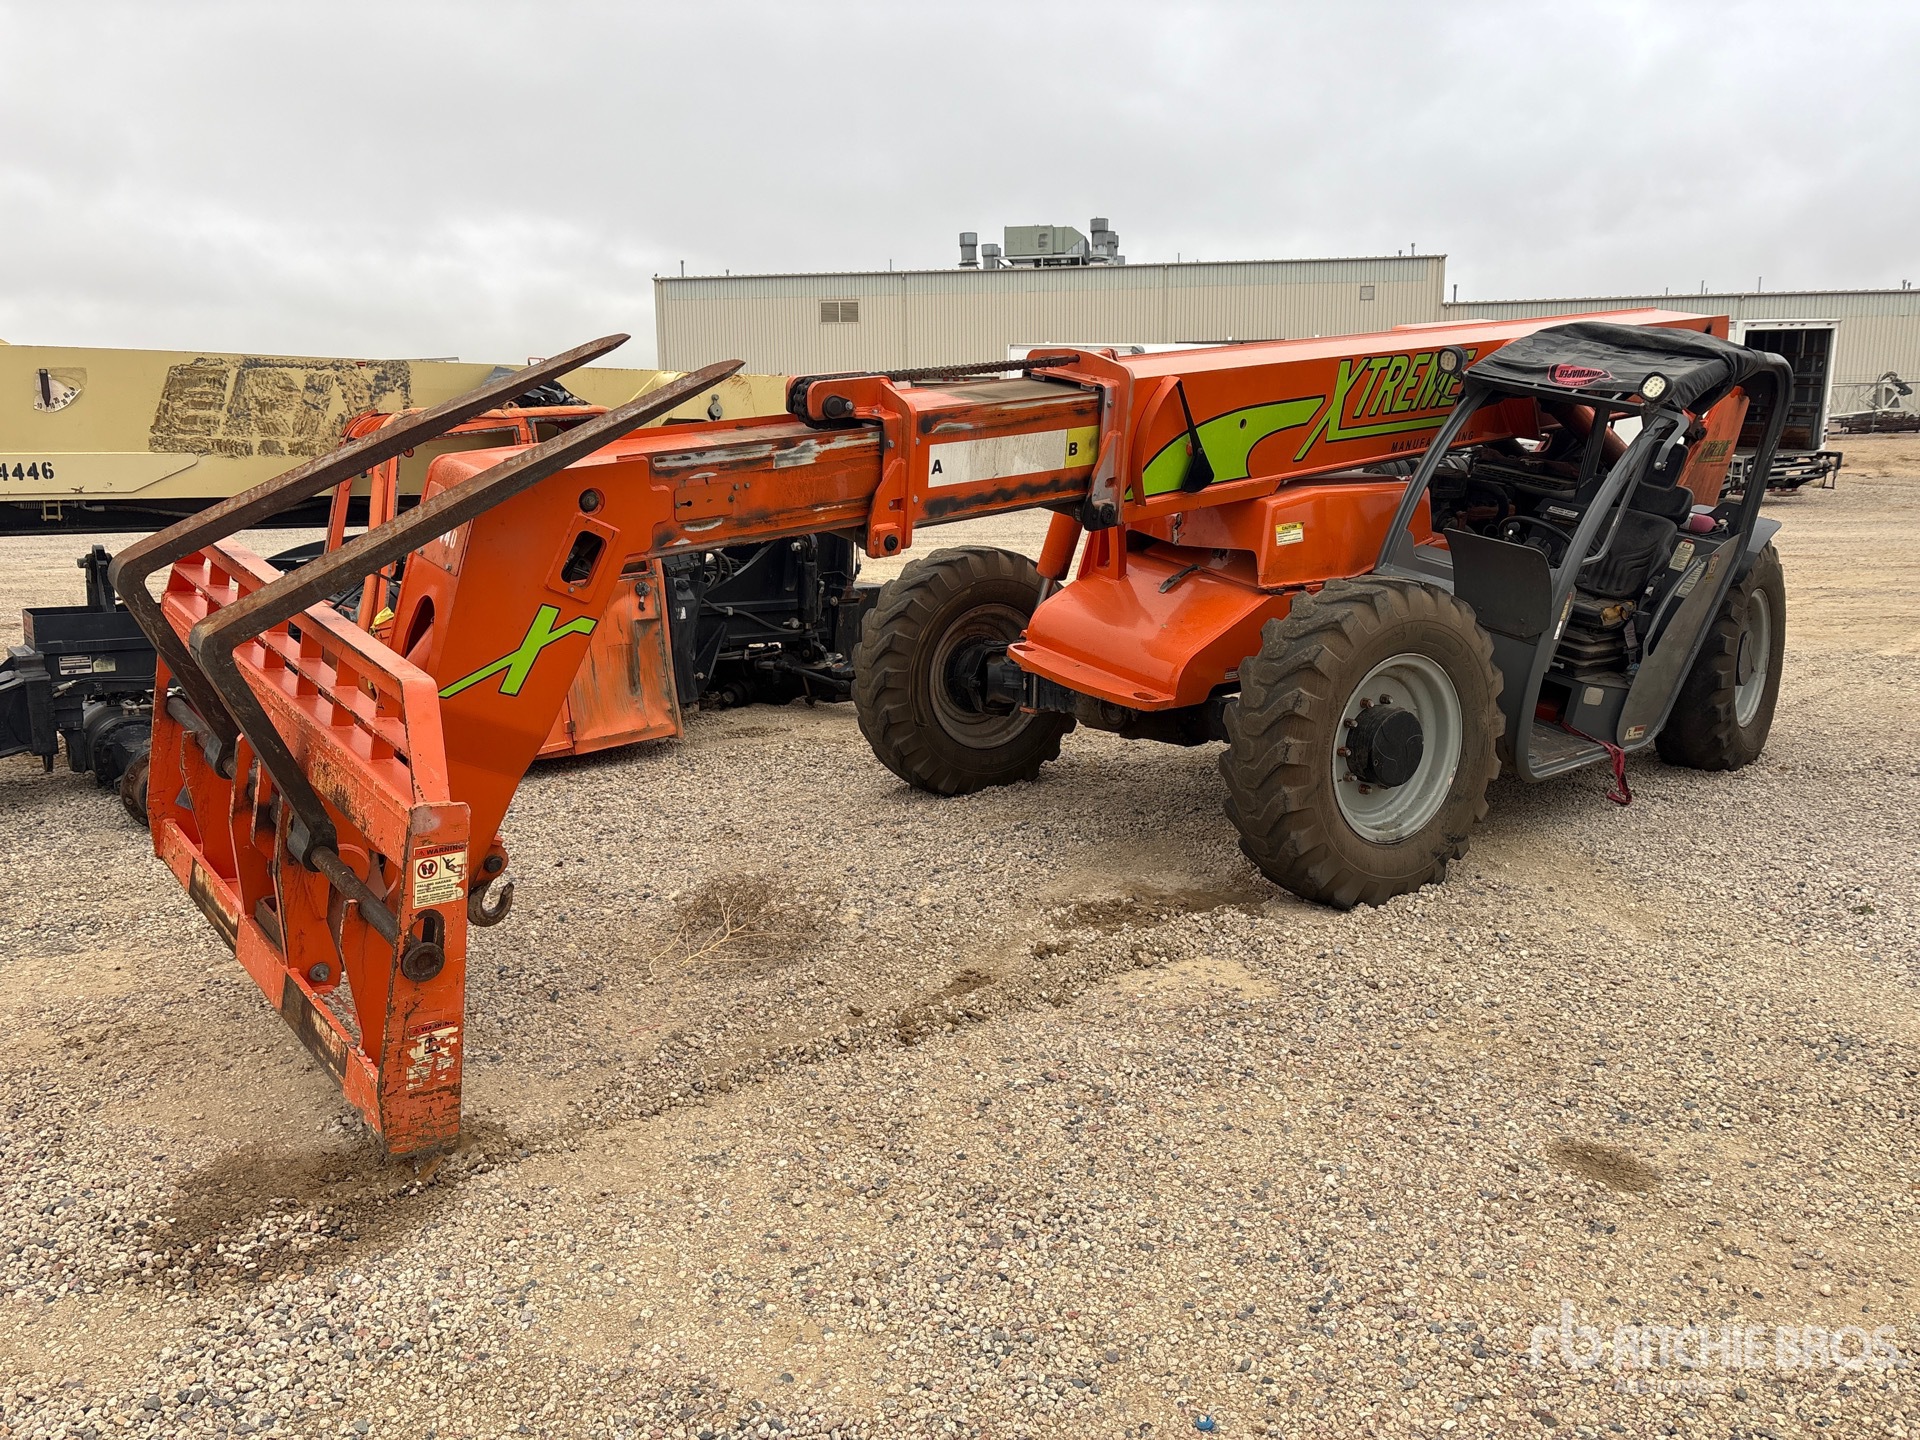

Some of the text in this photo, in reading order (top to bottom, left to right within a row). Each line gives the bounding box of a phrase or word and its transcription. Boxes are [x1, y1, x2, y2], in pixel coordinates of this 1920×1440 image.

[1293, 348, 1478, 462] XTREME
[1068, 442, 1079, 457] B
[1391, 431, 1474, 453] MANUFAING
[931, 459, 943, 475] A
[426, 844, 464, 855] WARNING
